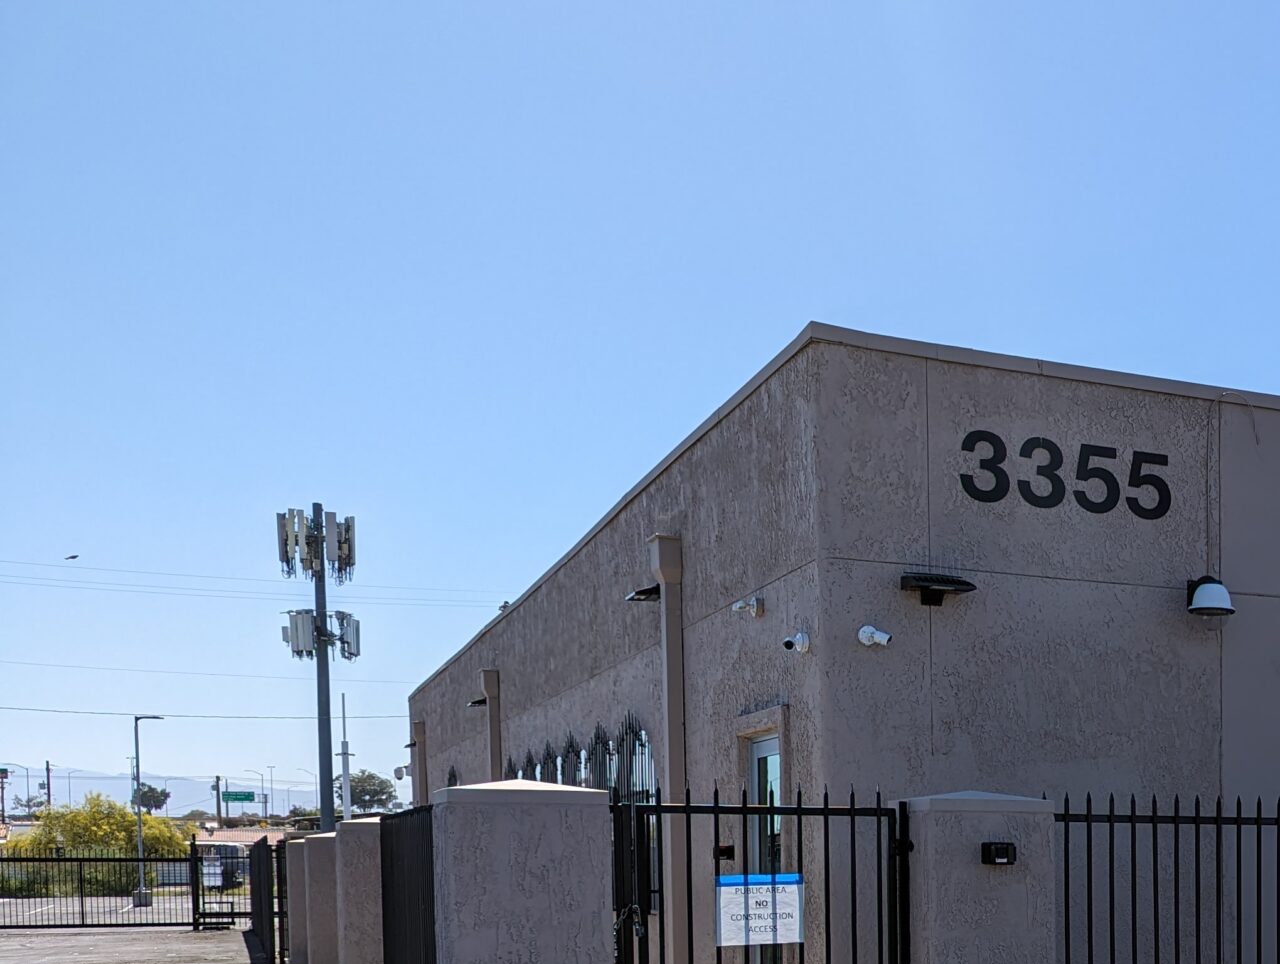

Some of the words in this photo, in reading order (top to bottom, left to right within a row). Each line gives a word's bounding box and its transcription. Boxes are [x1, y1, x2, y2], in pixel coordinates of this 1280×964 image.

[960, 430, 1172, 520] 3355
[735, 887, 763, 895] PUBLIC
[765, 886, 787, 894] AREA
[755, 900, 769, 908] NO
[730, 912, 794, 922] CONSTRUCTION
[748, 925, 778, 933] ACCESS
